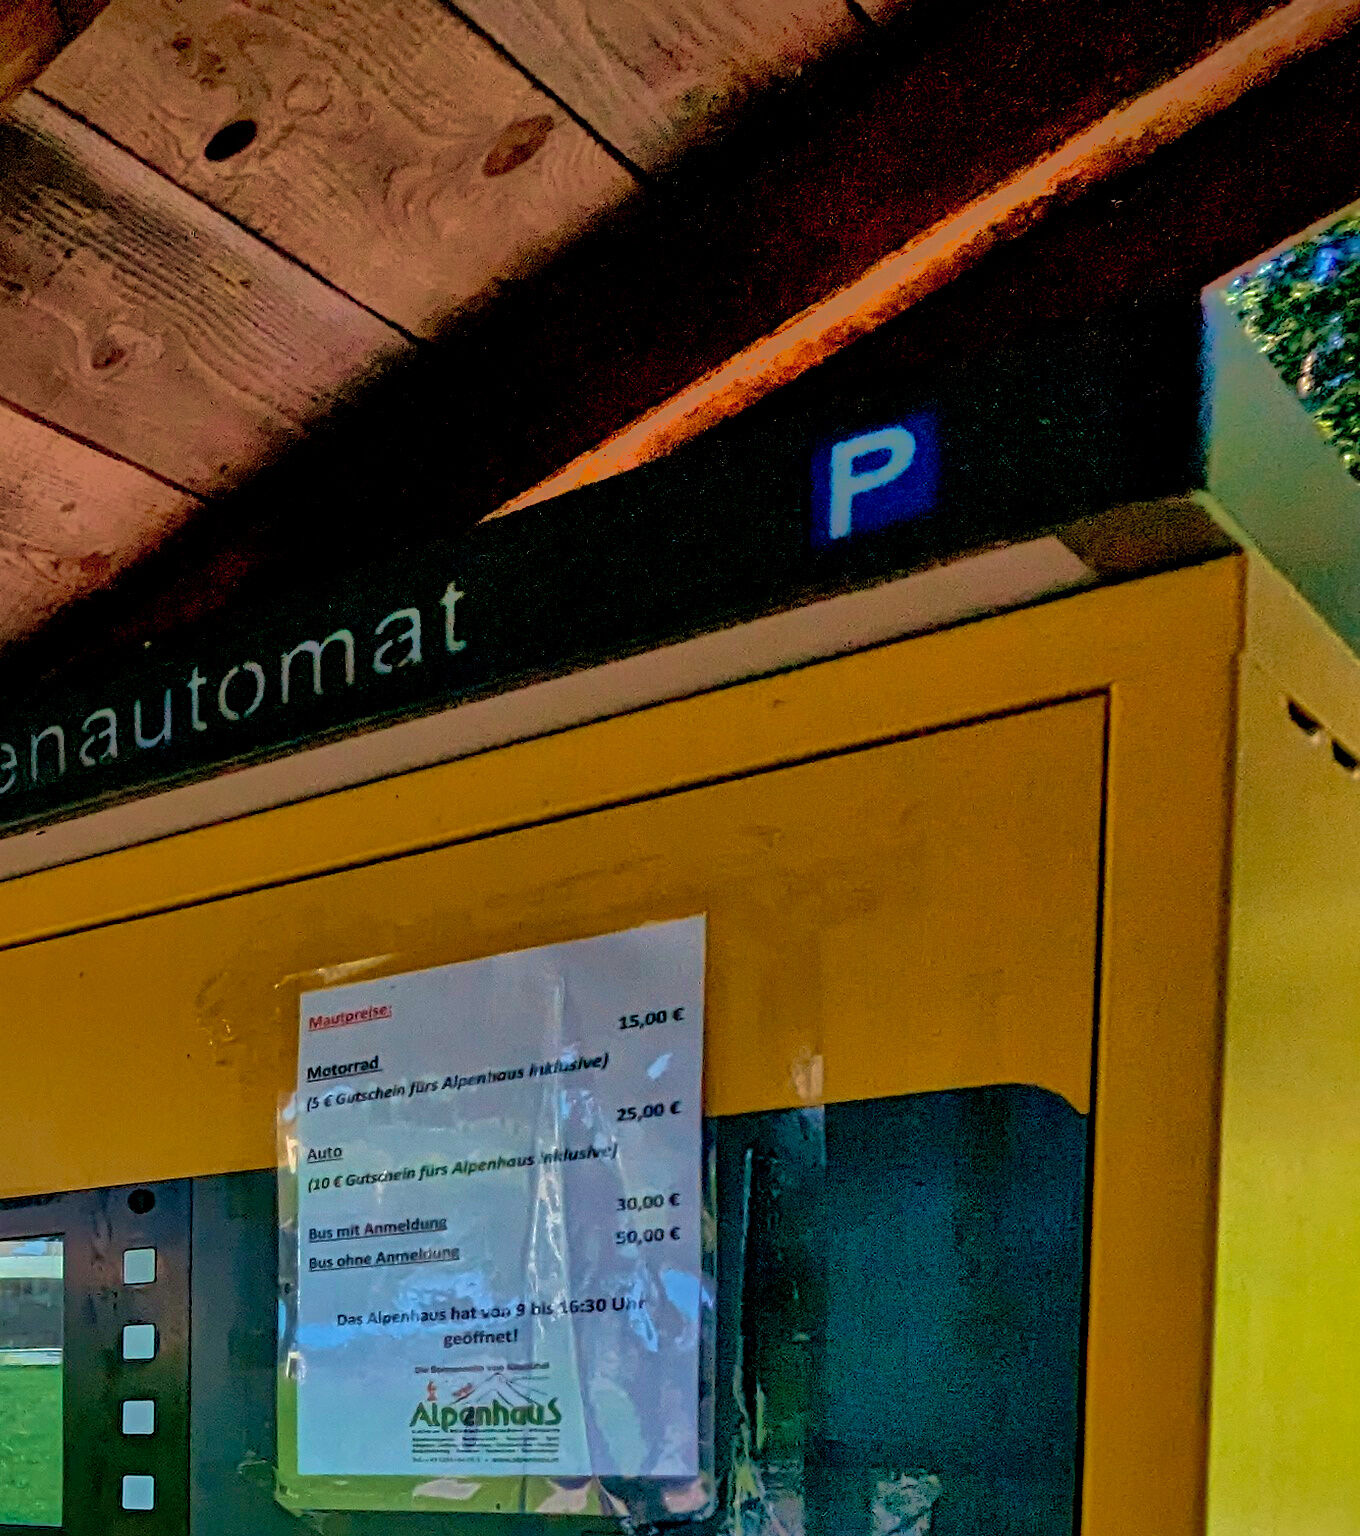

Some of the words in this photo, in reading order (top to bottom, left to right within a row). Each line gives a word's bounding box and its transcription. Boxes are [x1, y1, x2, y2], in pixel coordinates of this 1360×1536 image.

[830, 425, 916, 539] P
[618, 1010, 668, 1030] 15,00
[672, 1007, 685, 1021] €
[307, 1055, 380, 1080] Motorrad
[335, 1082, 405, 1106] Gutschein
[409, 1077, 438, 1096] fürs
[442, 1067, 524, 1091] Alpenhaus
[529, 1052, 610, 1077] inklusive)
[616, 1105, 665, 1122] 25,00
[669, 1101, 682, 1114] €
[307, 1146, 343, 1162] Auto
[308, 1177, 330, 1193] (10
[334, 1175, 343, 1188] €
[346, 1166, 415, 1187] Gutschein
[418, 1163, 448, 1182] fürs
[451, 1154, 535, 1177] Alpenhaus
[616, 1194, 665, 1212] 30,00
[669, 1193, 681, 1206] €
[309, 1227, 333, 1240] Bus
[337, 1224, 360, 1237] mit
[364, 1216, 447, 1235] Anmeldung
[615, 1228, 665, 1246] 50,00
[670, 1227, 681, 1240] €
[309, 1257, 334, 1270] Bus
[337, 1253, 372, 1267] ohne
[376, 1247, 460, 1266] Anmeldung
[337, 1313, 363, 1326] Das
[368, 1308, 446, 1325] Alpenhaus
[451, 1306, 477, 1321] hat
[480, 1306, 512, 1319] von
[516, 1304, 526, 1317] 9
[530, 1302, 555, 1316] bis
[561, 1298, 607, 1315] 16:30
[443, 1328, 518, 1349] geöffnet!
